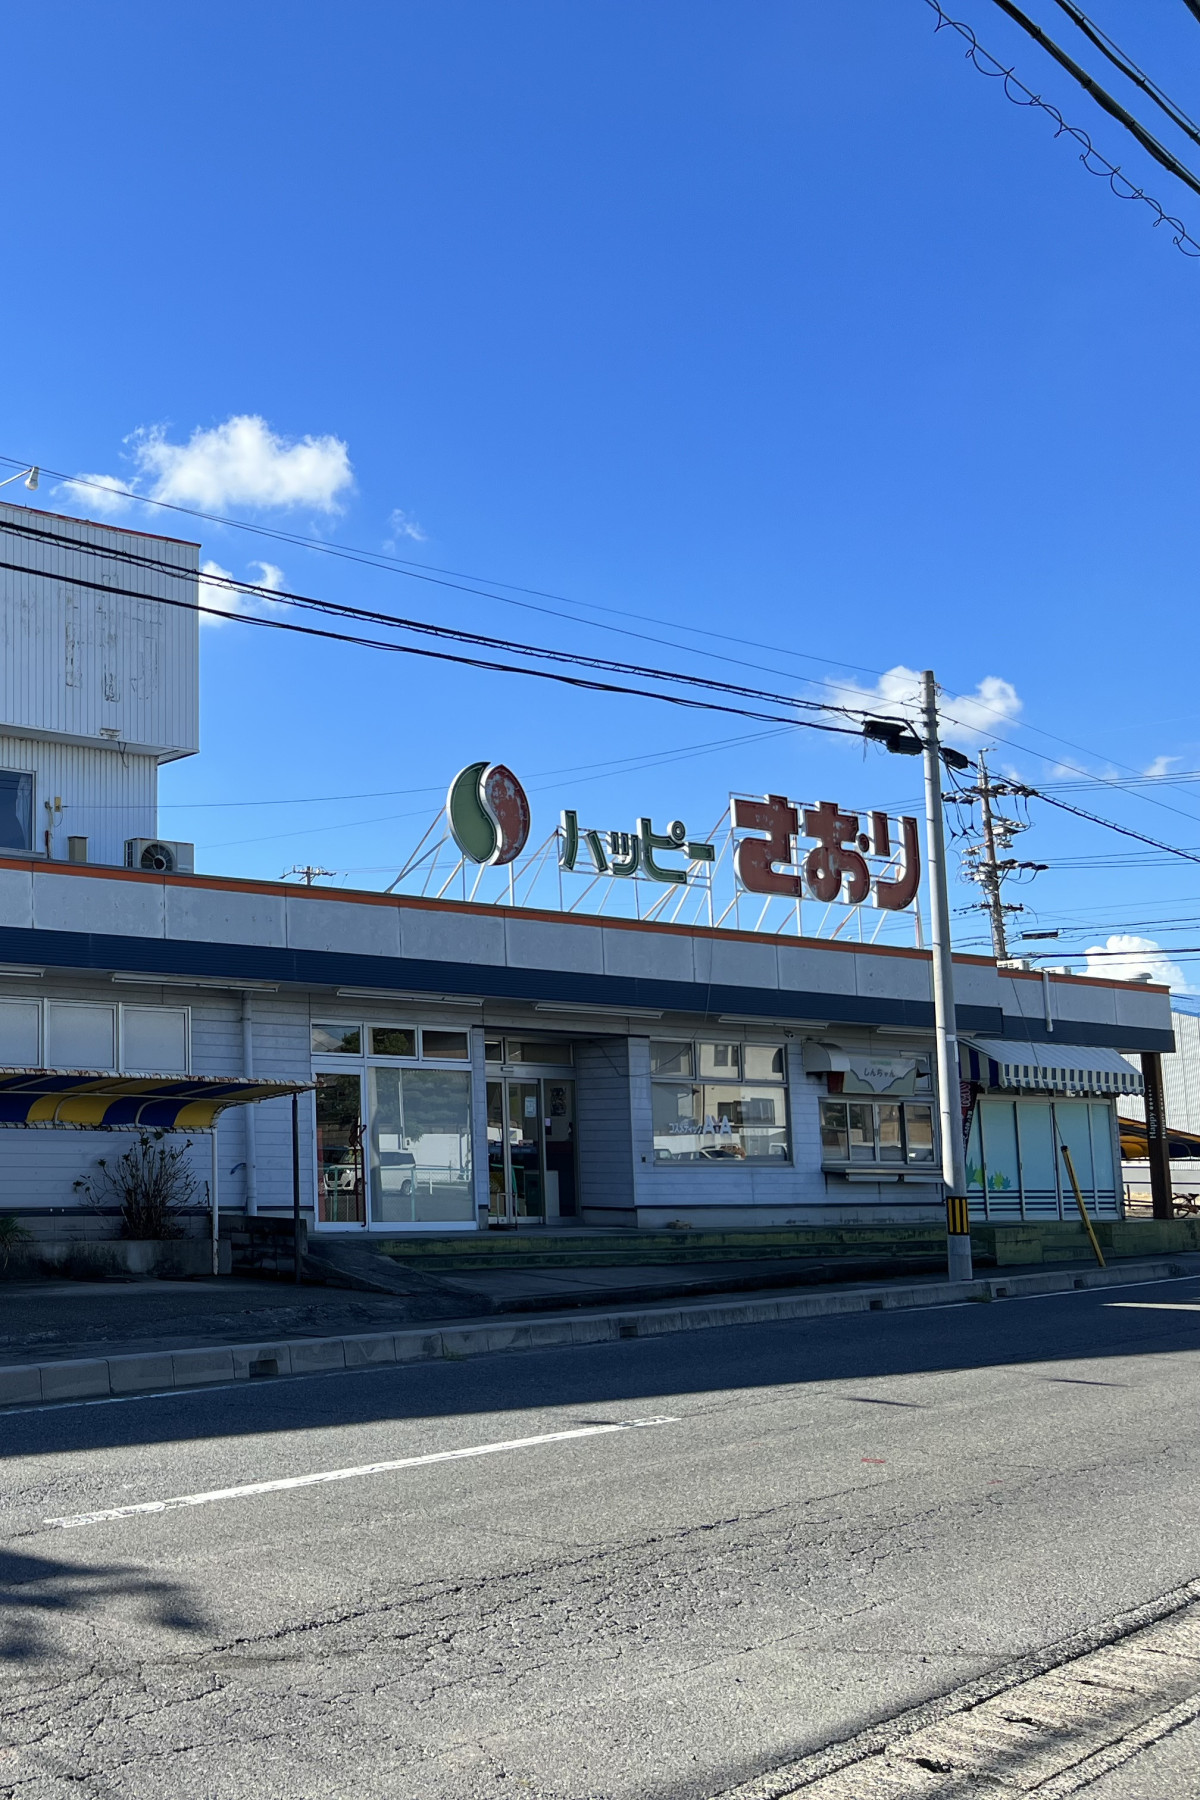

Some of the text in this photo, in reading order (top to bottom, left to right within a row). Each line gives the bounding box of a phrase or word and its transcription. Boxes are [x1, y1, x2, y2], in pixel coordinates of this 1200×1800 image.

[559, 794, 921, 911] ハッピー さおり
[863, 1067, 896, 1078] しんちゃん
[1149, 1112, 1158, 1139] Happy
